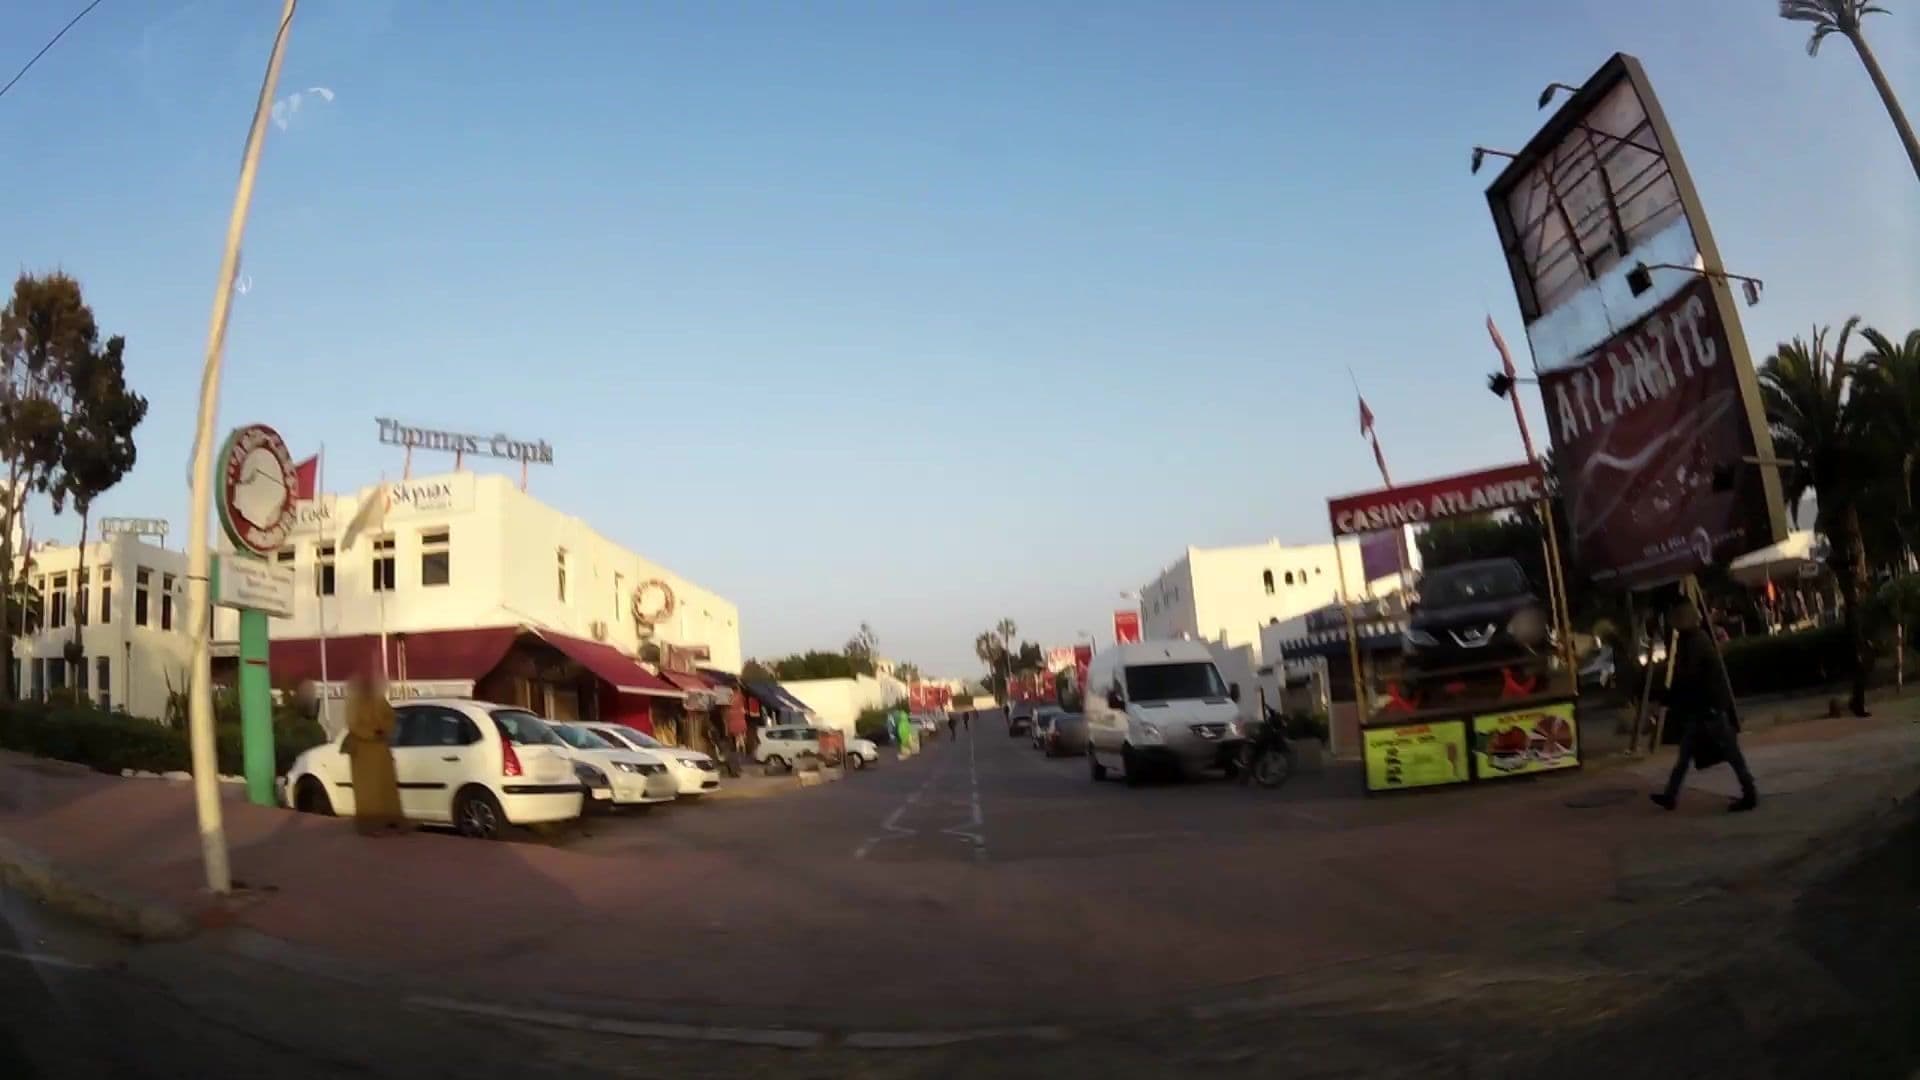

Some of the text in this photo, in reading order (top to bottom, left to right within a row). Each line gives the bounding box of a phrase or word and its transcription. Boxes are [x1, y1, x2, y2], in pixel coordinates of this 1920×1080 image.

[1554, 294, 1717, 444] ATLANTIC
[375, 416, 480, 455] Thomas
[1336, 475, 1541, 534] CASINO ATLANTIC
